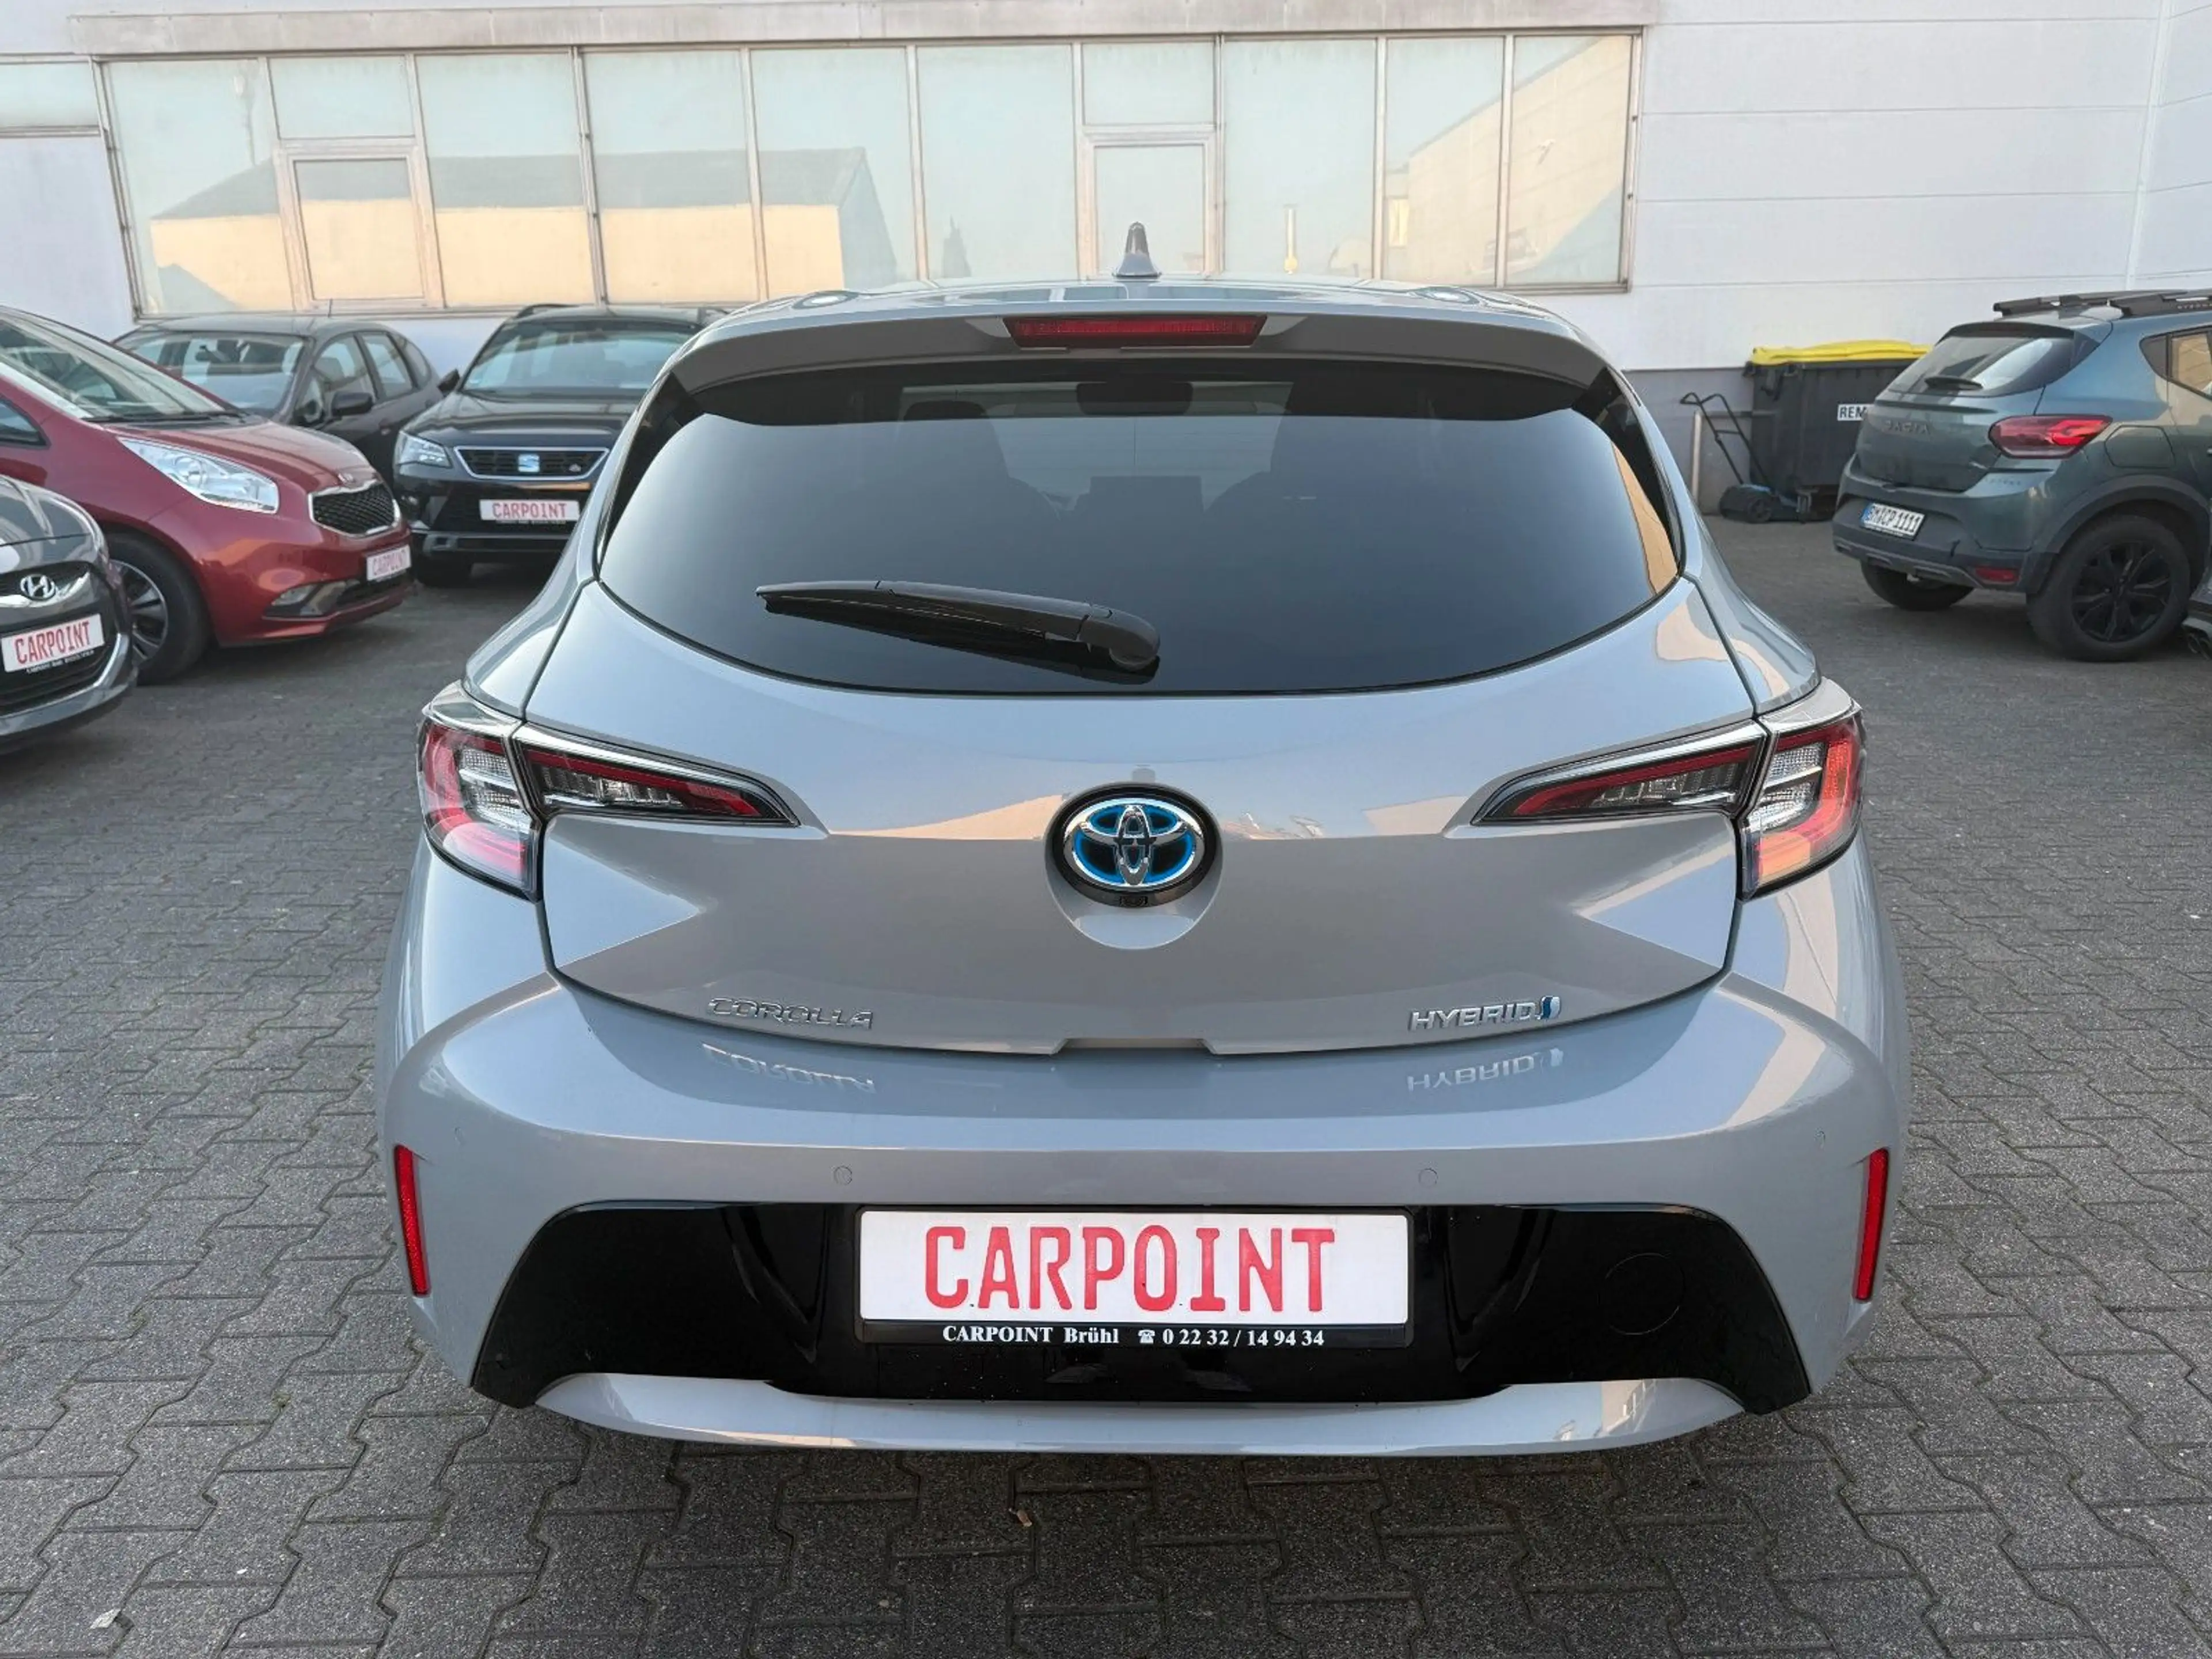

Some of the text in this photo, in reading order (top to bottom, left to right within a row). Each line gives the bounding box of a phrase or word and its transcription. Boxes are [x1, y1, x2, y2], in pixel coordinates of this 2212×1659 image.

[492, 502, 567, 519] CARPOINT
[373, 548, 407, 576] CARPOINT
[15, 621, 90, 664] CARPOINT
[708, 997, 873, 1029] COROLLA
[1408, 1001, 1537, 1031] HYBRID
[925, 1225, 1335, 1313] CARPOINT
[942, 1325, 1053, 1342] CARPOINT
[1063, 1327, 1119, 1343] Brühl
[1162, 1328, 1175, 1344] 0
[1179, 1328, 1201, 1345] 22
[1206, 1329, 1230, 1346] 32
[1247, 1330, 1268, 1346] 14
[1273, 1330, 1296, 1346] 94
[1301, 1330, 1324, 1346] 34
